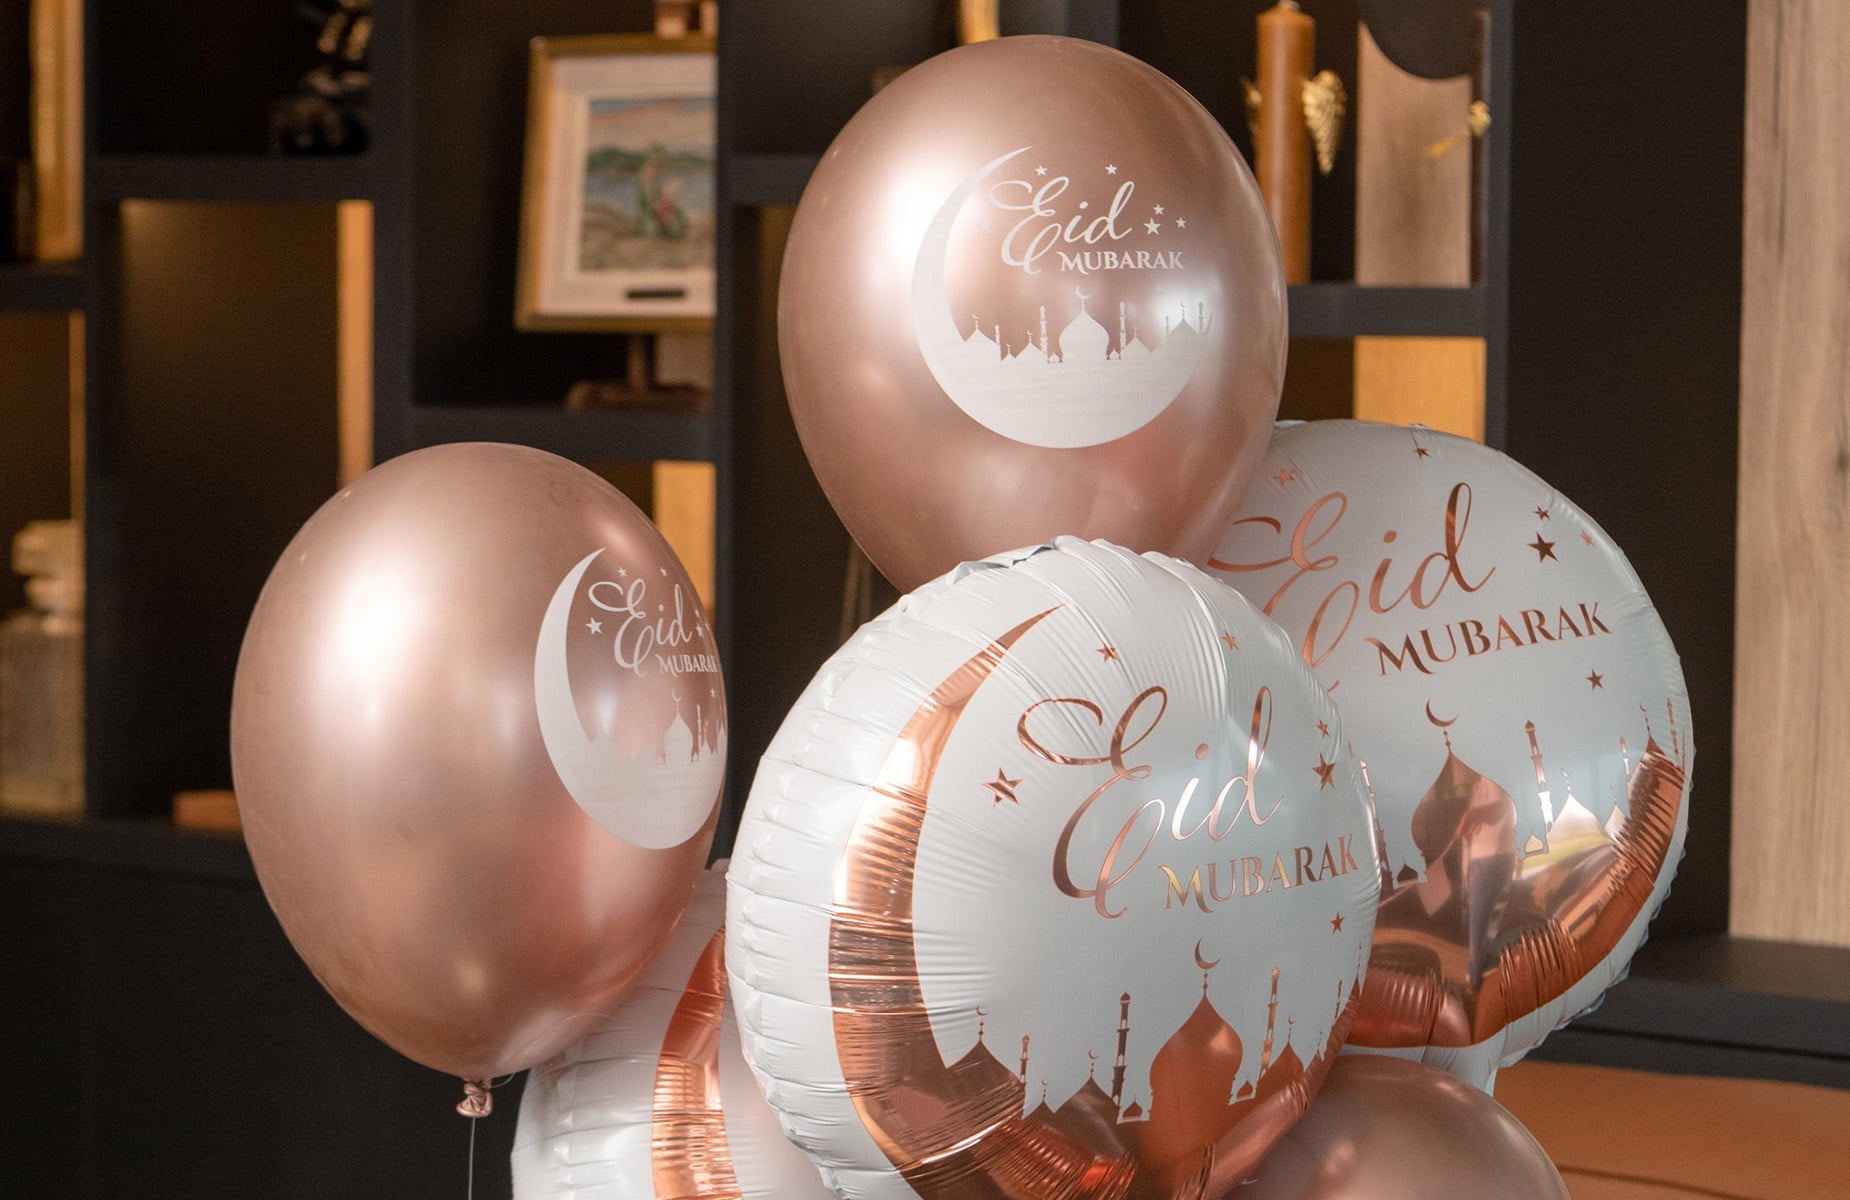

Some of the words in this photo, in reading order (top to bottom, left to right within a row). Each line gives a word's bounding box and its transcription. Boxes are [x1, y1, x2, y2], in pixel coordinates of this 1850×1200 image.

[987, 175, 1135, 276] Eid
[1056, 250, 1185, 275] MUBARAK
[588, 577, 693, 678] Eid
[1362, 601, 1613, 677] MUBARAK
[1016, 684, 1286, 920] Eid
[1157, 832, 1360, 914] MUBARAK
